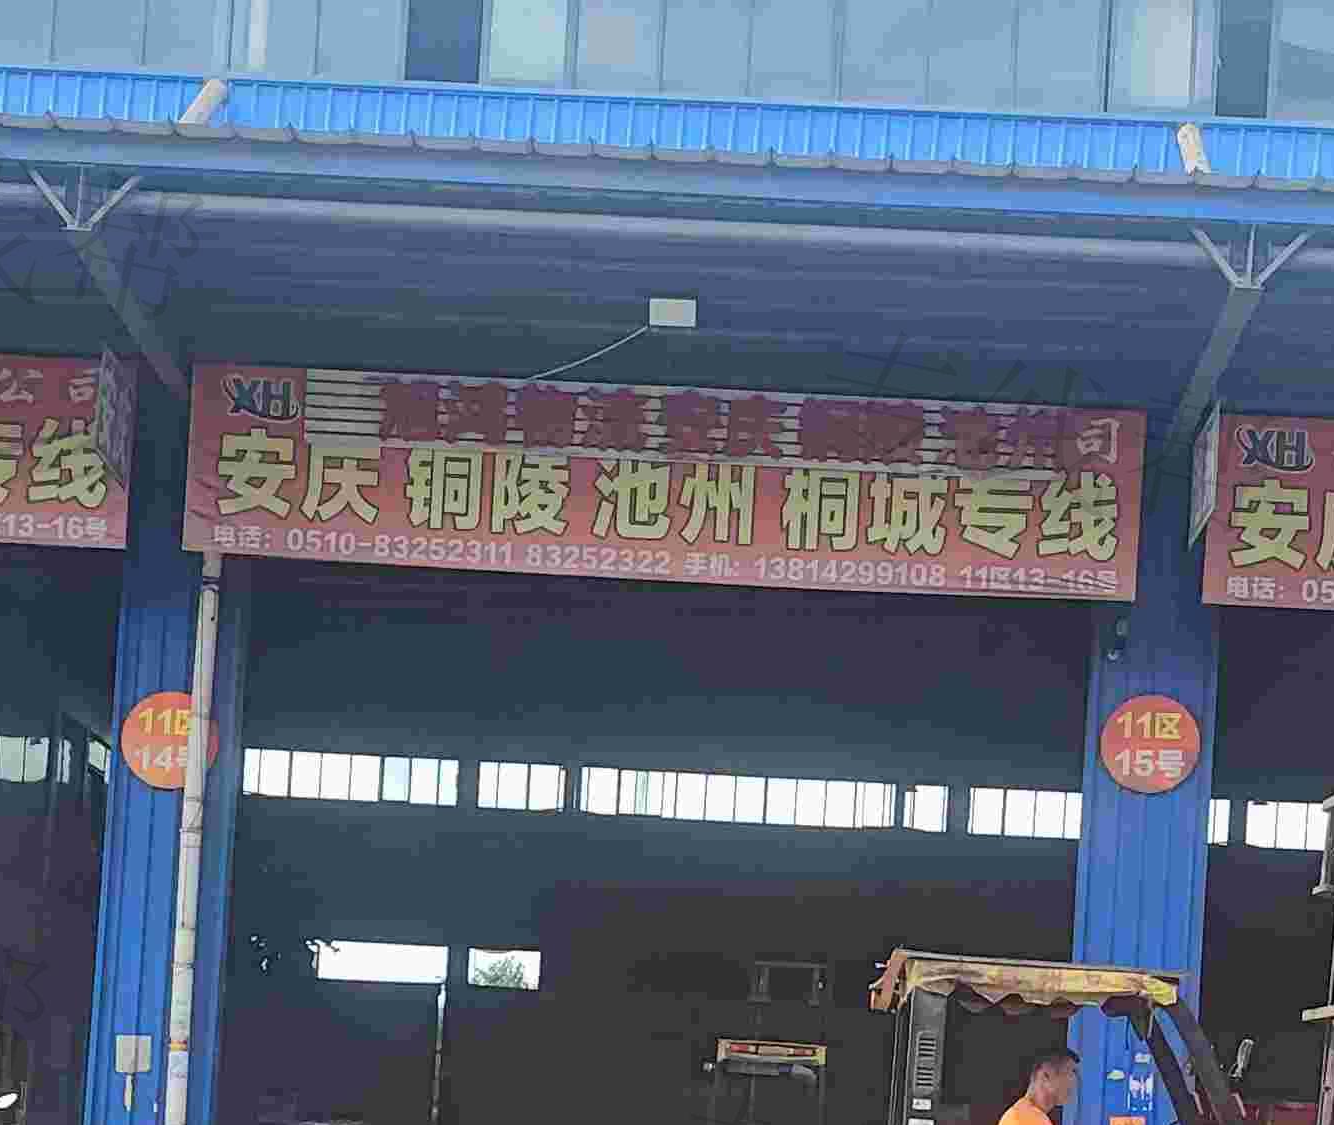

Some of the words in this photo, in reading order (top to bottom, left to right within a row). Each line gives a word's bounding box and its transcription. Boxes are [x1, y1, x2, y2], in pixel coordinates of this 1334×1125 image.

[217, 428, 380, 524] 安庆
[405, 447, 570, 535] 铜陵
[593, 456, 755, 546] 池州
[781, 468, 1119, 562] 桐城专线
[285, 528, 513, 566] 0510-83252311
[525, 545, 670, 577] 83252322
[754, 557, 946, 588] 13814299108
[1115, 710, 1183, 742] 11区
[1114, 749, 1186, 782] 15号
